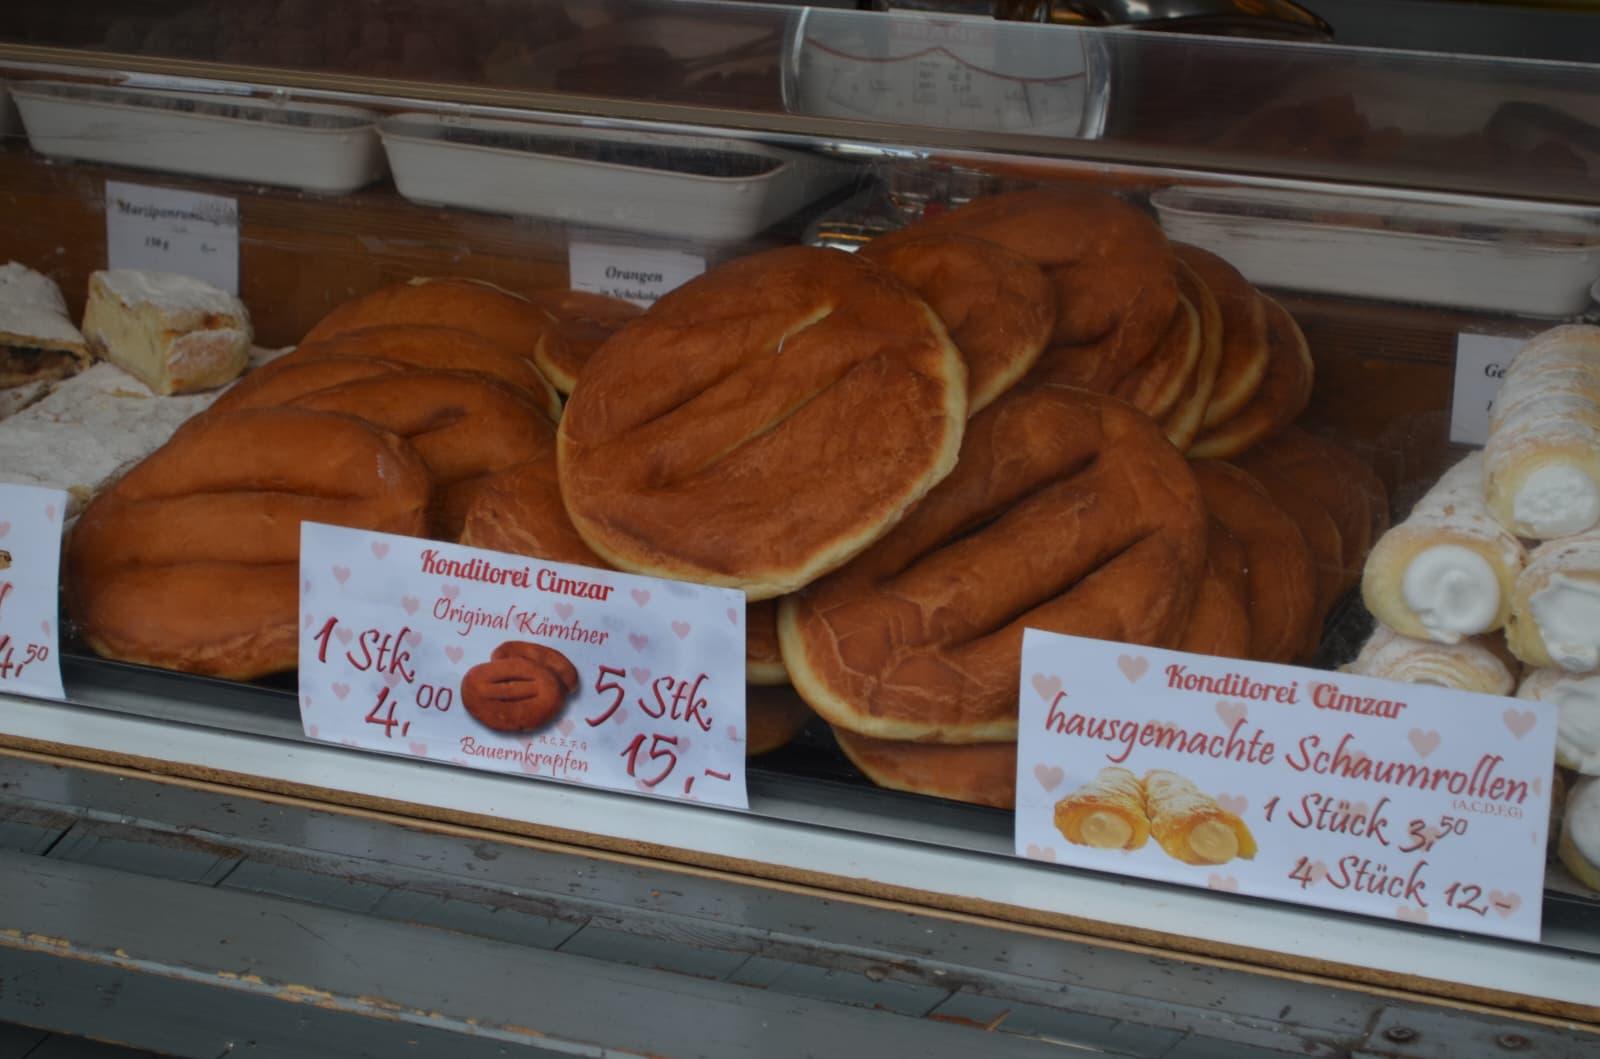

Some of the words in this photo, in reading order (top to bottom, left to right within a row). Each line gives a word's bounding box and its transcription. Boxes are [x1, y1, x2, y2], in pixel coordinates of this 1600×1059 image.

[605, 266, 663, 285] Orangen
[1485, 363, 1506, 379] Ge
[420, 549, 530, 588] Konditorei
[536, 568, 614, 601] Cimzar
[313, 616, 339, 664] 1
[433, 597, 516, 636] Original
[516, 612, 609, 645] Kärntner
[585, 665, 626, 727] 5
[1165, 664, 1300, 705] Konditorei
[1312, 683, 1407, 719] Cimzar
[460, 736, 588, 776] Bauernkrapfen
[1045, 691, 1275, 765] hausgemachte
[1285, 733, 1528, 804] Schaumrollen
[1264, 796, 1280, 822] 1
[1288, 793, 1391, 847] Stück
[1399, 816, 1468, 853] 3,50
[1289, 857, 1312, 889] 4
[1326, 856, 1430, 908] Stück
